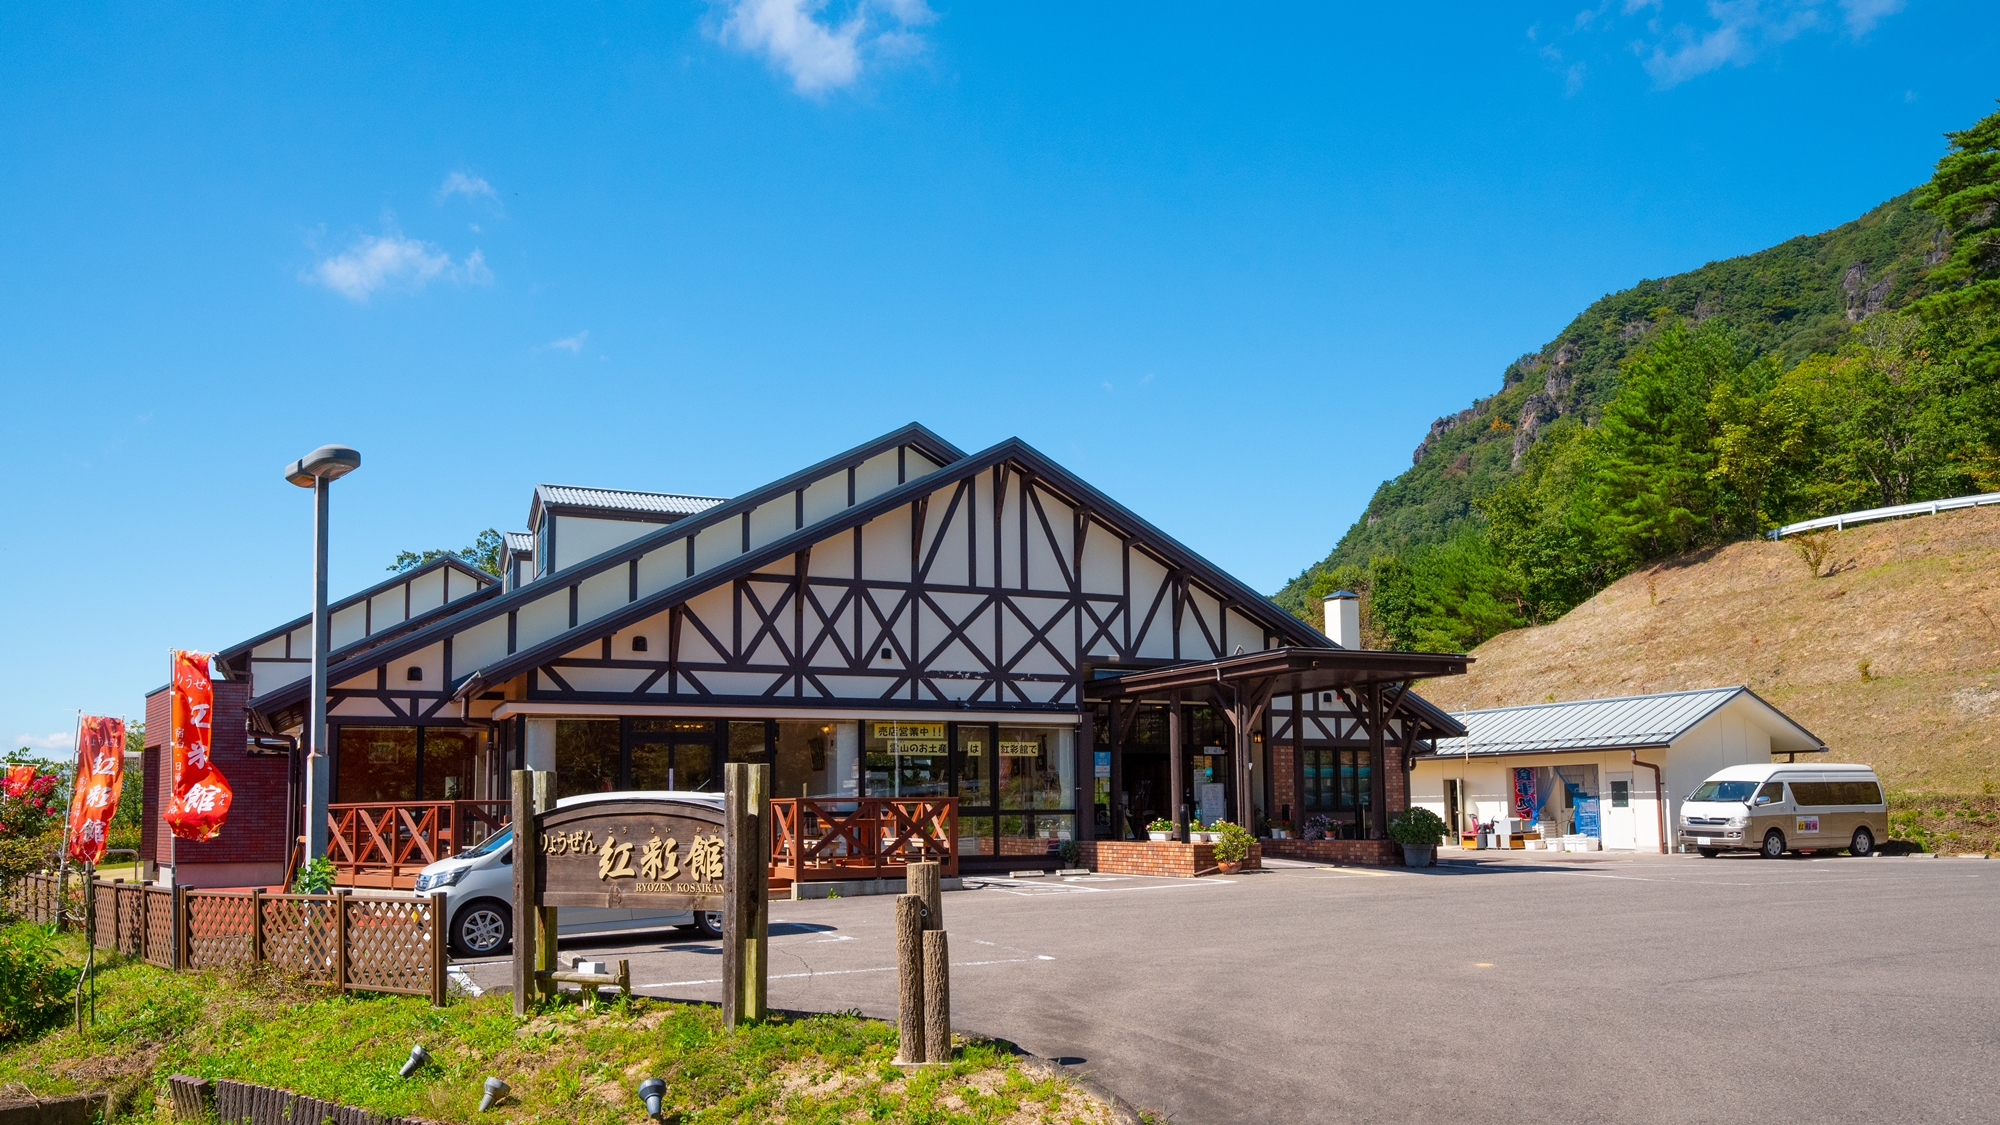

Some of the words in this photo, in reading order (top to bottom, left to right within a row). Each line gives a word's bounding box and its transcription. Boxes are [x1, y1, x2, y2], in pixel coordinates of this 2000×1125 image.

[84, 735, 120, 748] りょうぜん
[970, 744, 979, 753] は
[1000, 744, 1037, 754] 紅彩館で
[80, 752, 116, 843] 紅彩館
[540, 830, 598, 854] りょうぜん
[599, 835, 725, 881] 紅彩館
[635, 882, 673, 893] RYOZEN
[676, 882, 725, 894] KOSAIKAN
